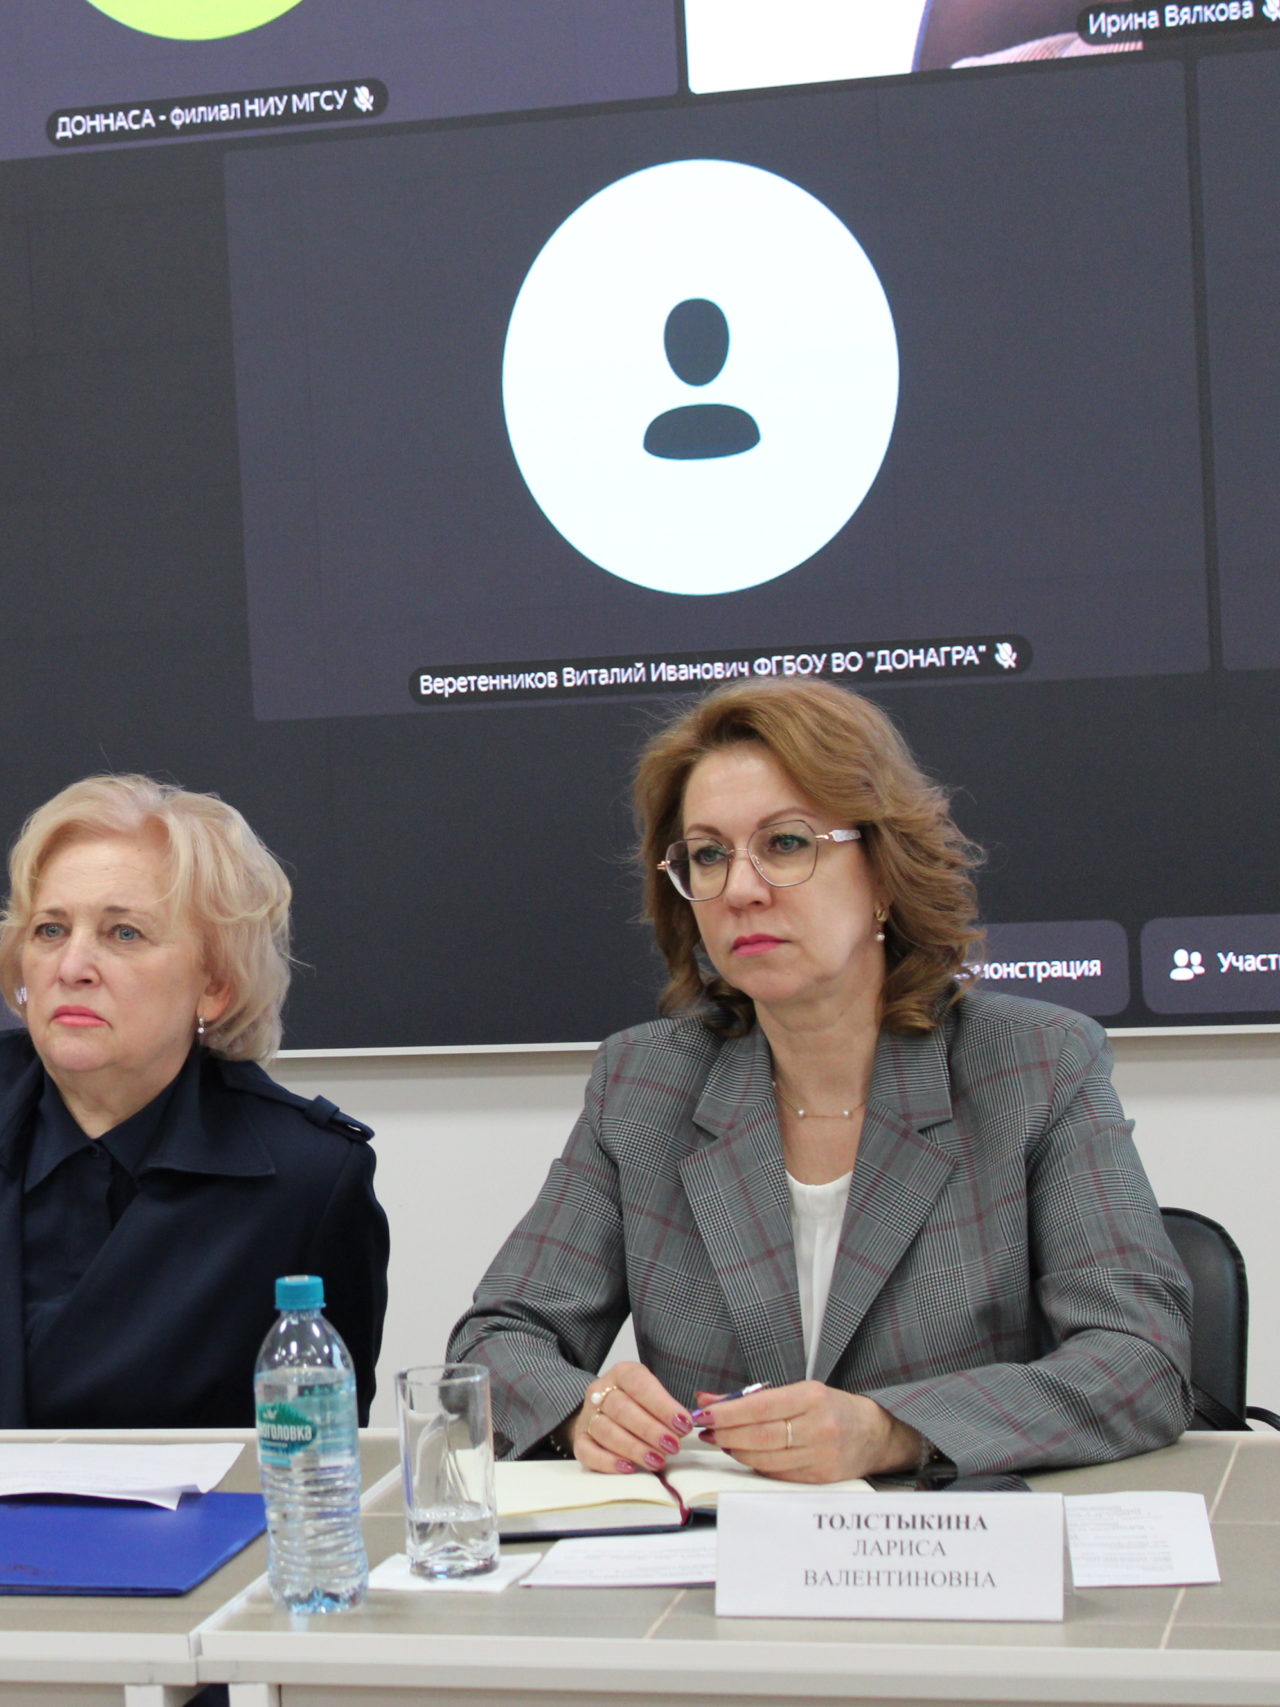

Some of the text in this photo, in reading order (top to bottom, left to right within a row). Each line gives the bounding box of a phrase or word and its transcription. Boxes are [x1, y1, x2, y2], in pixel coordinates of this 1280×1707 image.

[1088, 0, 1254, 37] Ирина Вялкова
[55, 108, 156, 139] ДОННАСА
[169, 102, 241, 130] филиал
[244, 94, 288, 118] НИУ
[291, 88, 348, 114] МГСУ
[419, 644, 987, 698] Веретенников Виталий Иванович ФГБОУ ВО "ДОНАГРА"
[1216, 951, 1280, 973] Участ
[812, 1512, 989, 1531] ТОЛСТЫКИНА
[852, 1538, 948, 1557] ЛАРИСА
[803, 1568, 997, 1589] ВАЛЕНТИНОВНА
